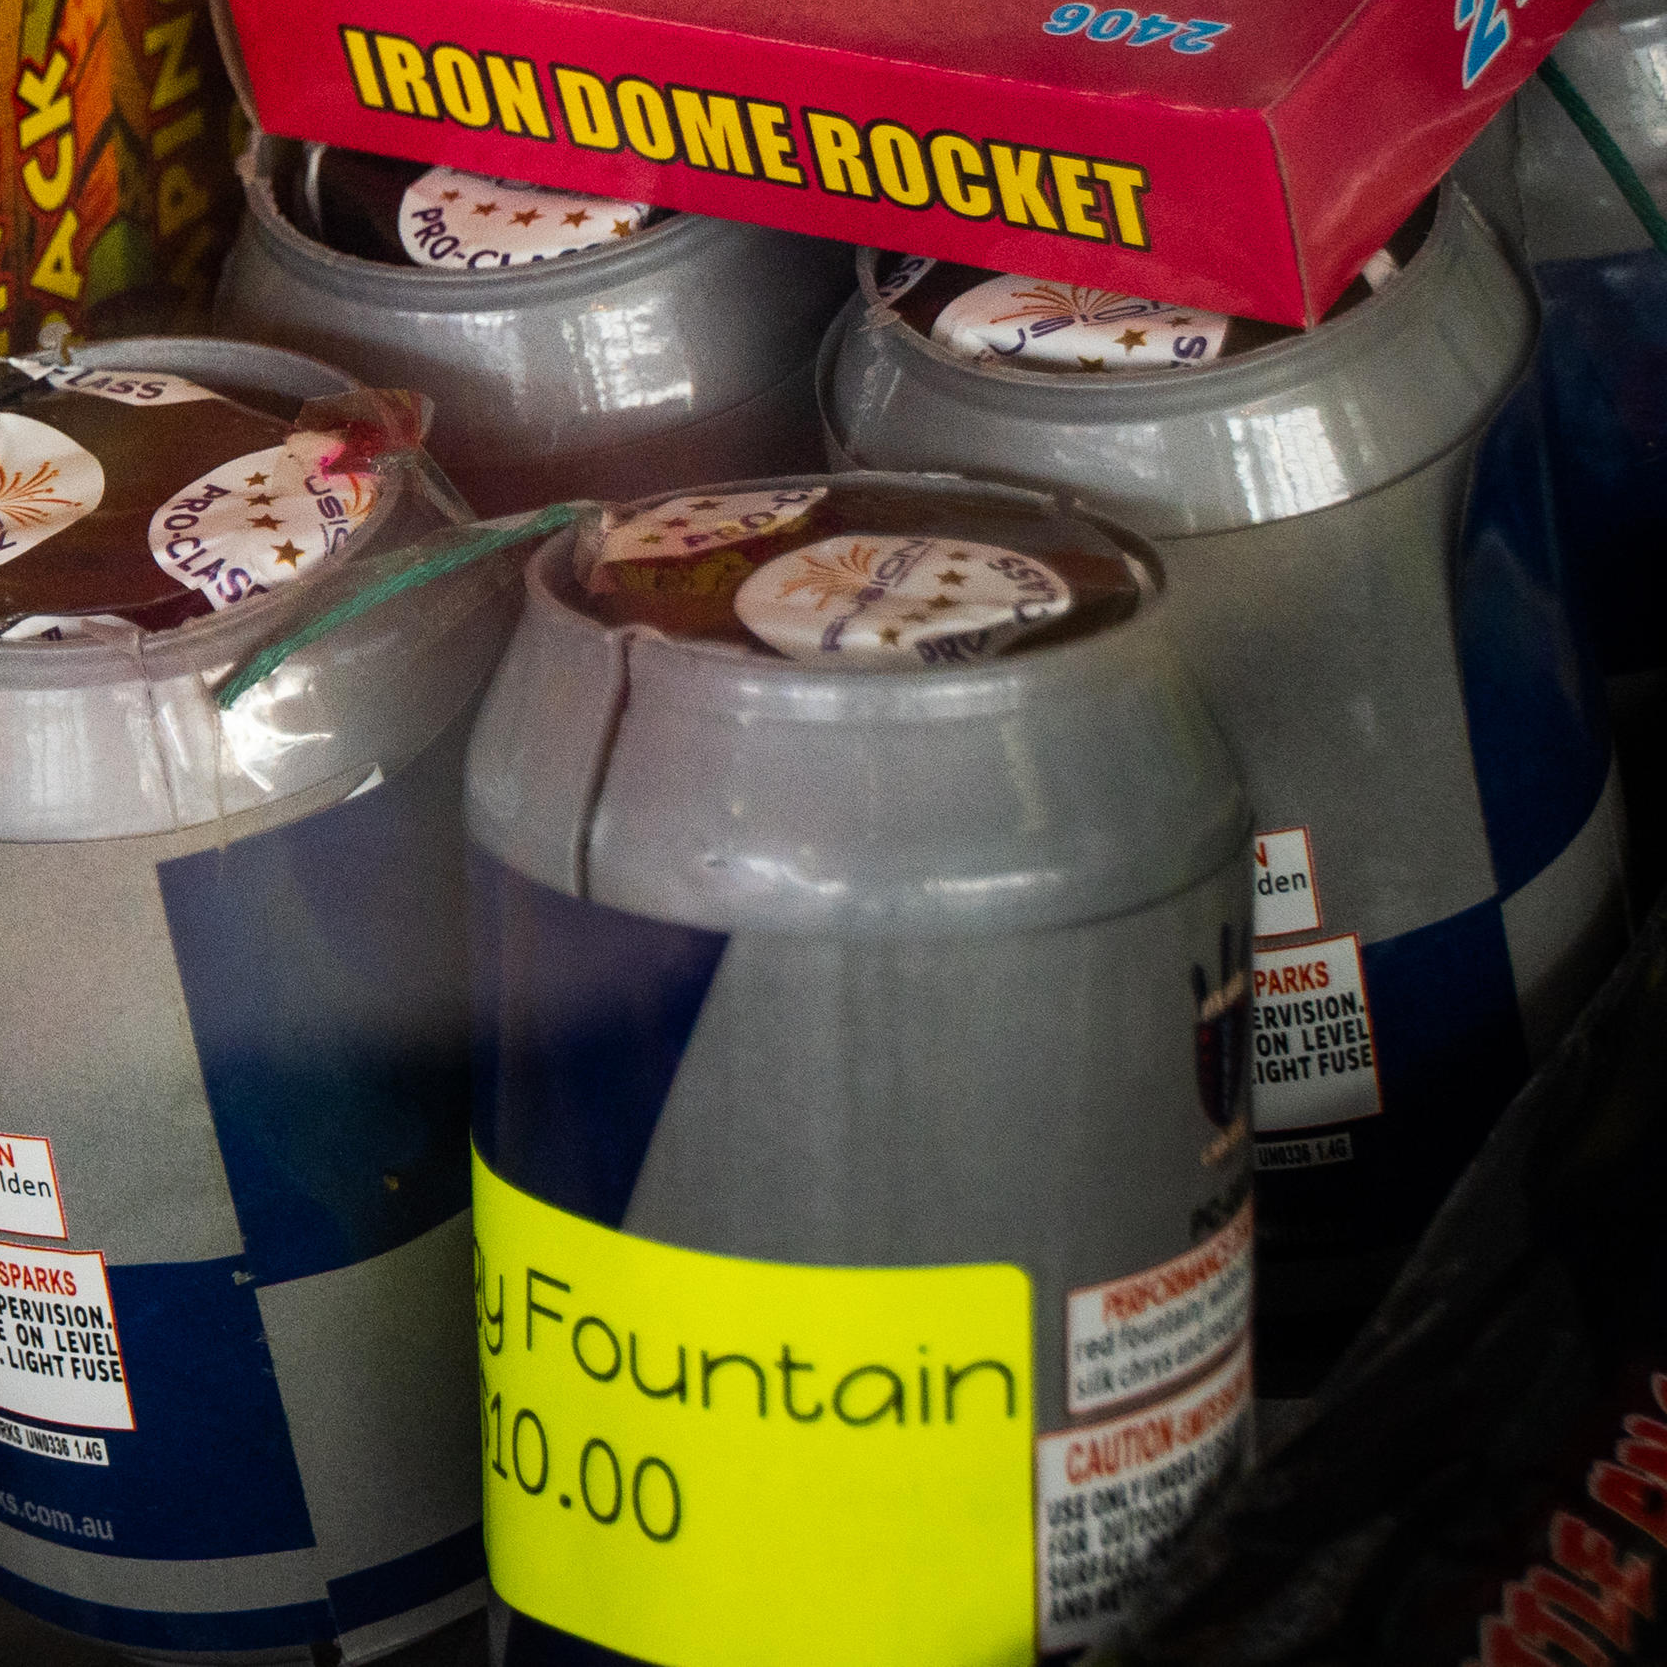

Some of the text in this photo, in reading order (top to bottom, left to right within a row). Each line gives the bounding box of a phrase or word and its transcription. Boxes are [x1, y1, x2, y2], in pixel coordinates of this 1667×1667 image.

[1042, 1, 1233, 56] 2406
[339, 24, 1153, 252] IRON DOME ROCKET
[1257, 1018, 1371, 1058] ON LEVEL
[1254, 1045, 1374, 1085] IGHT FUSE
[16, 1323, 45, 1350] ON
[54, 1328, 119, 1358] LEVEL
[525, 1263, 1020, 1429] Fountain
[6, 1344, 66, 1378] LIGHT
[70, 1356, 124, 1384] FUSE
[25, 1427, 71, 1459] UN0336
[73, 1438, 104, 1463] 1.4G
